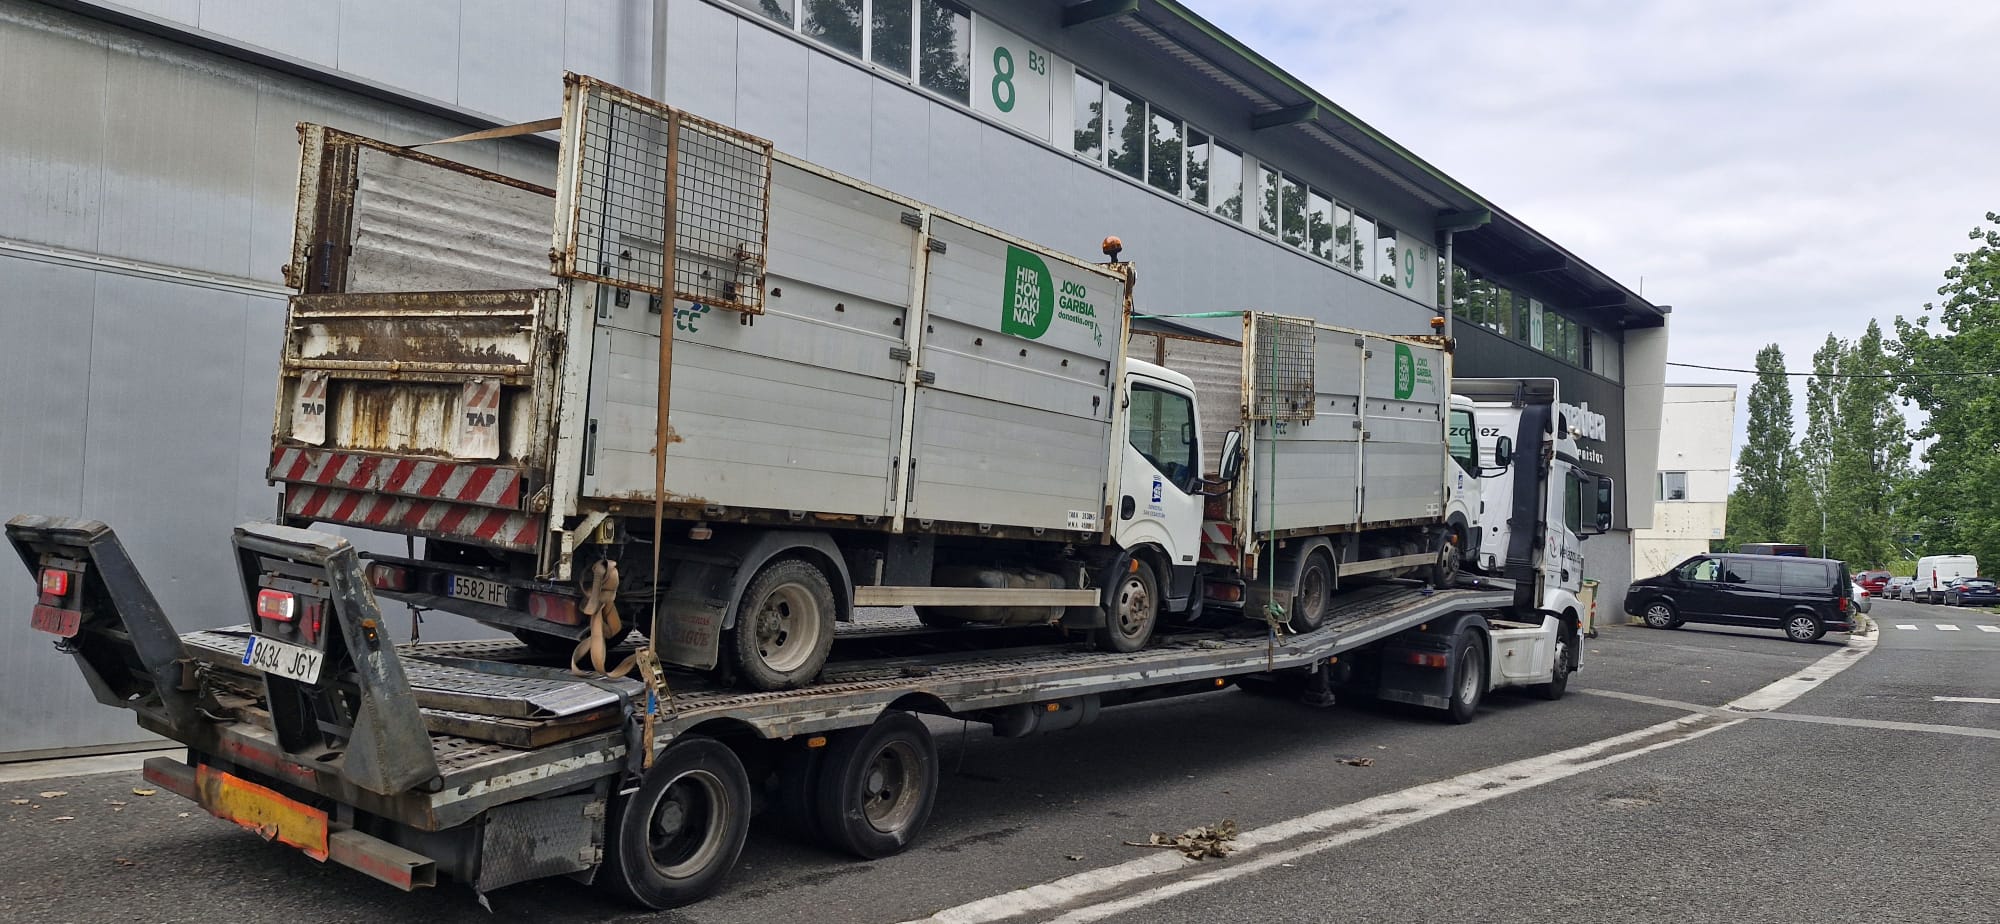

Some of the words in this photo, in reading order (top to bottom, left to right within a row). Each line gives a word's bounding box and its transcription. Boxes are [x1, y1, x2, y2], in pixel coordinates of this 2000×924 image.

[1028, 49, 1046, 76] B3
[991, 46, 1015, 113] 8
[1016, 265, 1039, 286] HIRI
[1404, 248, 1414, 289] 9
[1015, 279, 1041, 300] HON
[1059, 279, 1087, 299] JOKO
[1014, 293, 1040, 314] DAKI
[1012, 307, 1037, 328] NAK
[1057, 310, 1095, 330] donostia.org
[1531, 317, 1542, 349] 10
[302, 401, 325, 416] TAP
[466, 412, 496, 427] TAP
[456, 577, 485, 600] 5582
[252, 641, 282, 671] 9434
[287, 652, 317, 680] JGY
